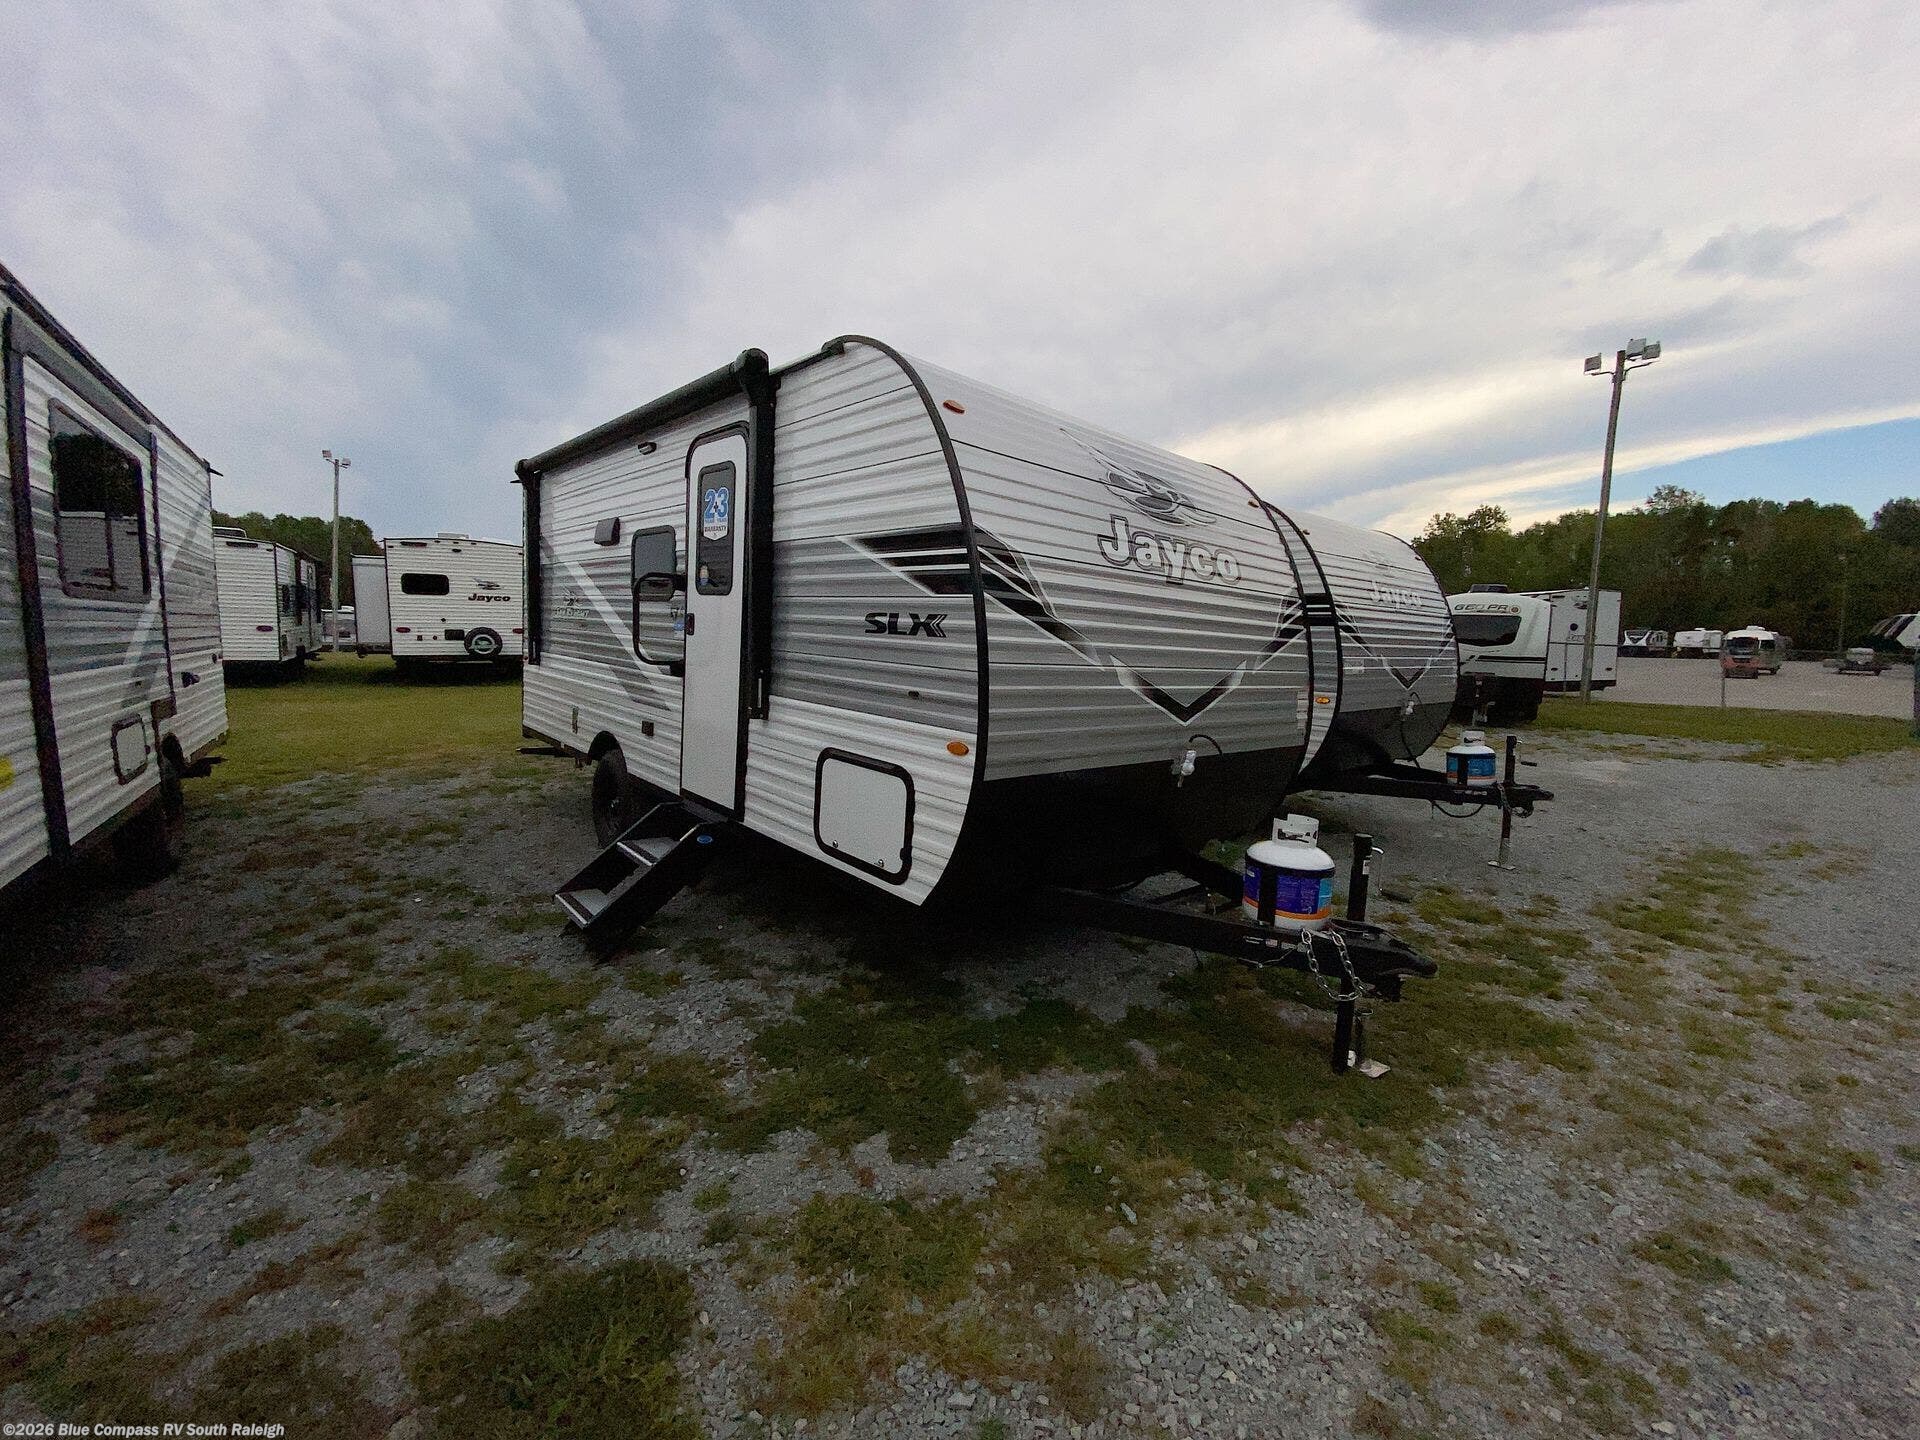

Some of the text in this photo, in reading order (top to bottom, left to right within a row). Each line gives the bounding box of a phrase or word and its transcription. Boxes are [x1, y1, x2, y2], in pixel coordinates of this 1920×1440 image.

[1097, 513, 1242, 585] Jayco
[468, 593, 511, 603] Jayco
[1369, 580, 1422, 611] Jayco
[865, 612, 948, 638] SLX
